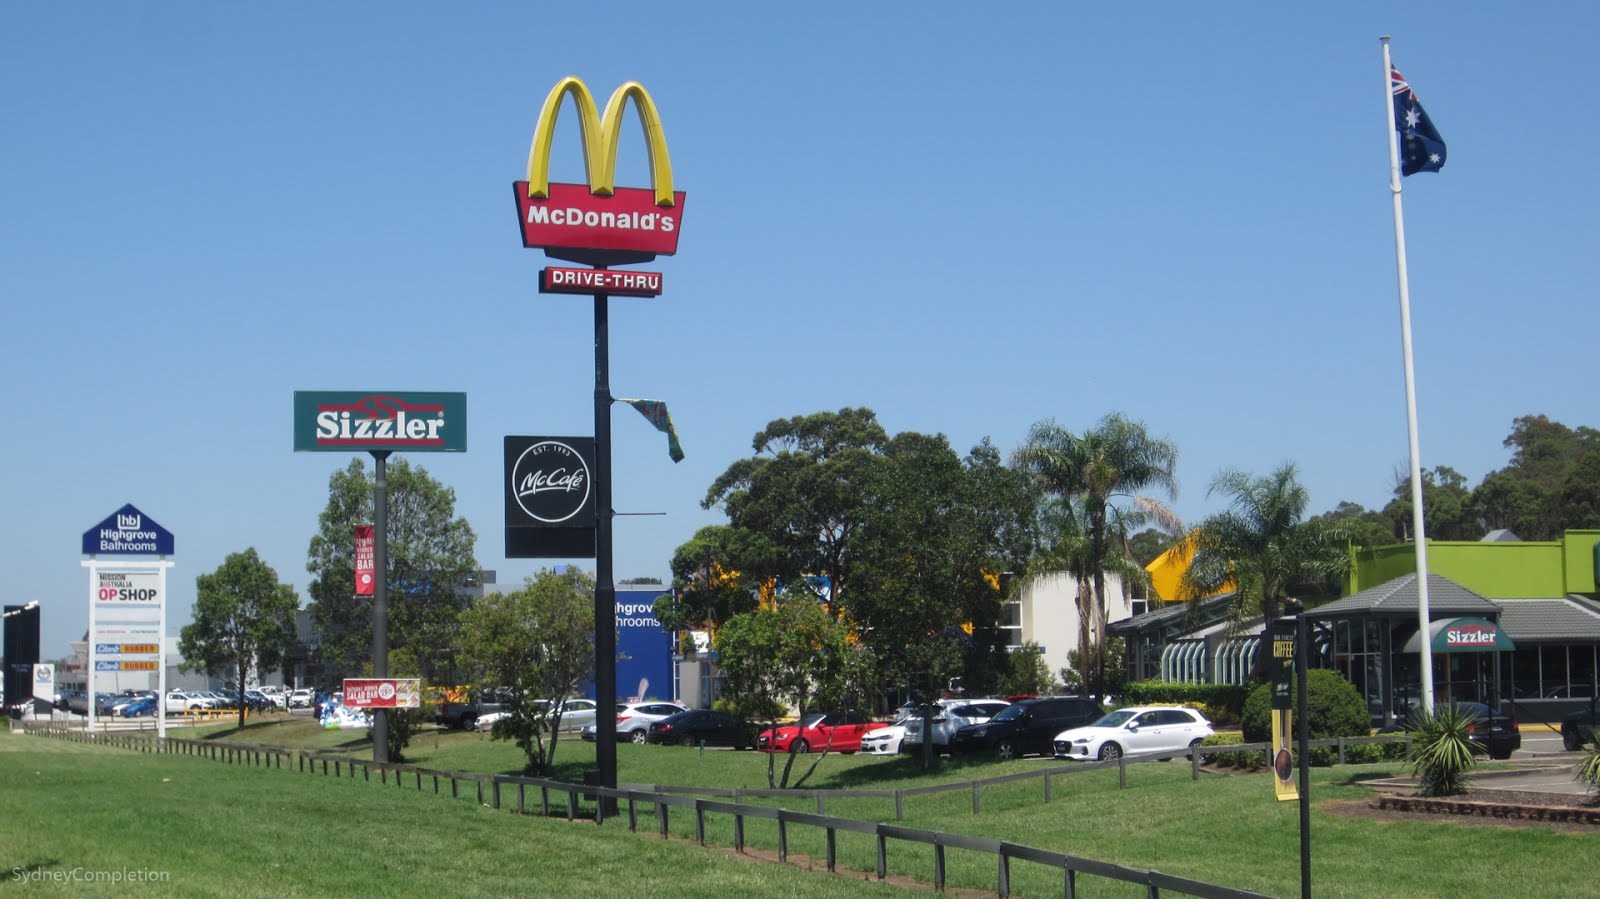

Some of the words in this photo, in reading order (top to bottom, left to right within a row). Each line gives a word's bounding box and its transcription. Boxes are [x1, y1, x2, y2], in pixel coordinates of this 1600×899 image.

[527, 205, 675, 232] McDonald's
[552, 270, 660, 290] DRIVE-THRU
[316, 410, 446, 439] Sizzler
[532, 445, 550, 456] EST.
[553, 445, 571, 457] 1993
[518, 467, 584, 495] McCafé
[100, 529, 157, 541] Highgrove
[100, 540, 157, 551] Bathrooms
[357, 559, 374, 570] BAR
[99, 573, 127, 581] MISSION
[98, 588, 118, 601] OP
[118, 588, 157, 601] SHOP
[614, 602, 653, 616] hgrov
[615, 616, 661, 627] hrooms
[1447, 630, 1496, 643] Sizzler
[1273, 641, 1294, 657] COFFEE
[346, 691, 366, 700] SALAD
